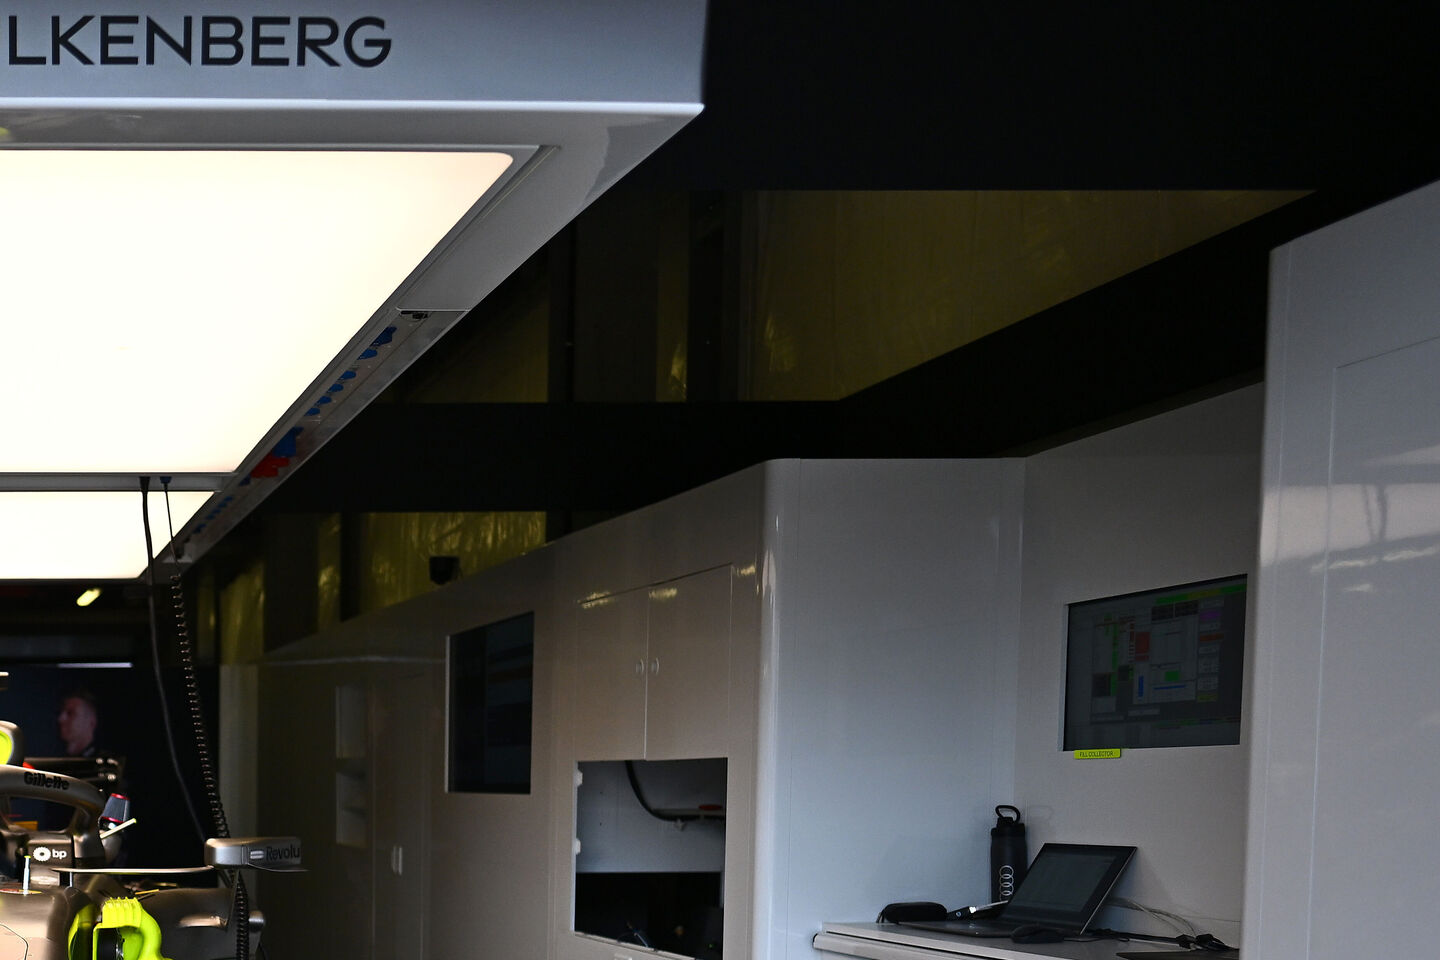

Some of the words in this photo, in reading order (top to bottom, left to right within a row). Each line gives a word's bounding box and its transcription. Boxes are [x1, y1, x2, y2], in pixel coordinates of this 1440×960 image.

[23, 771, 70, 791] Gillette
[52, 848, 67, 859] bp
[266, 844, 301, 861] Revolu
